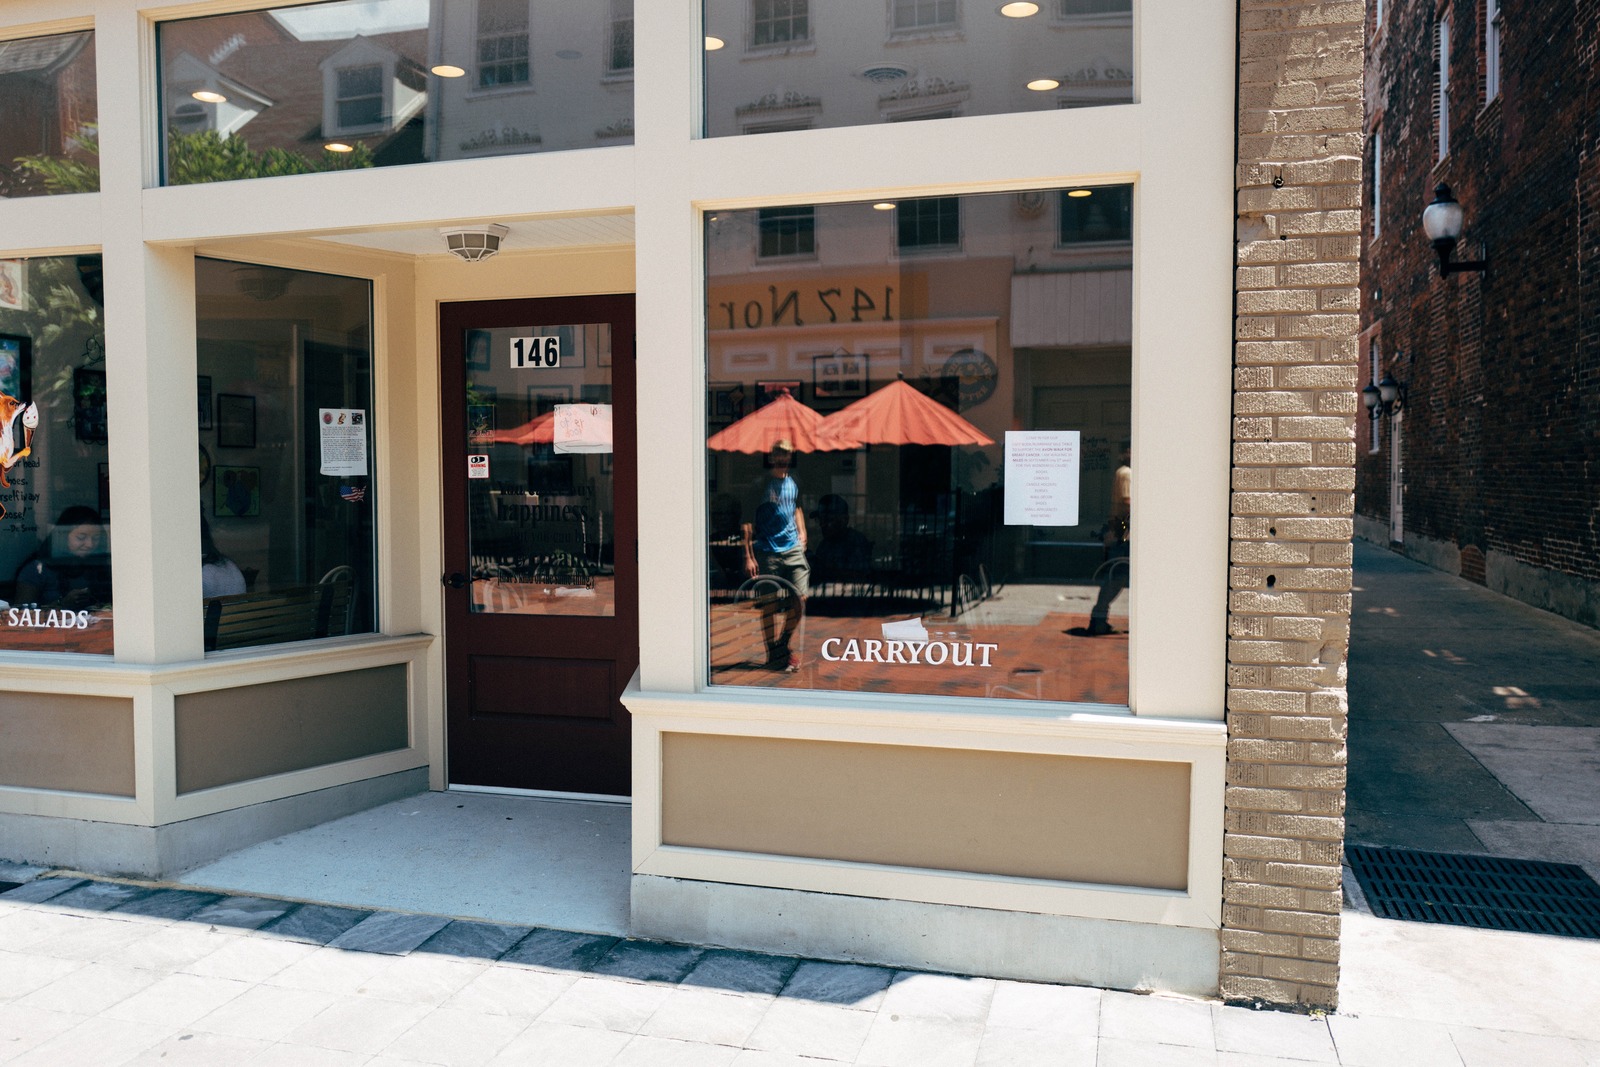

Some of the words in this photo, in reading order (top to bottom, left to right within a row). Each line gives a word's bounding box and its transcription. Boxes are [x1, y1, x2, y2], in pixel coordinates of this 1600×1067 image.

[514, 337, 558, 367] 146
[23, 457, 40, 468] head
[6, 476, 28, 486] hoes.
[8, 607, 88, 630] SALADS
[821, 637, 998, 668] CARRYOUT
